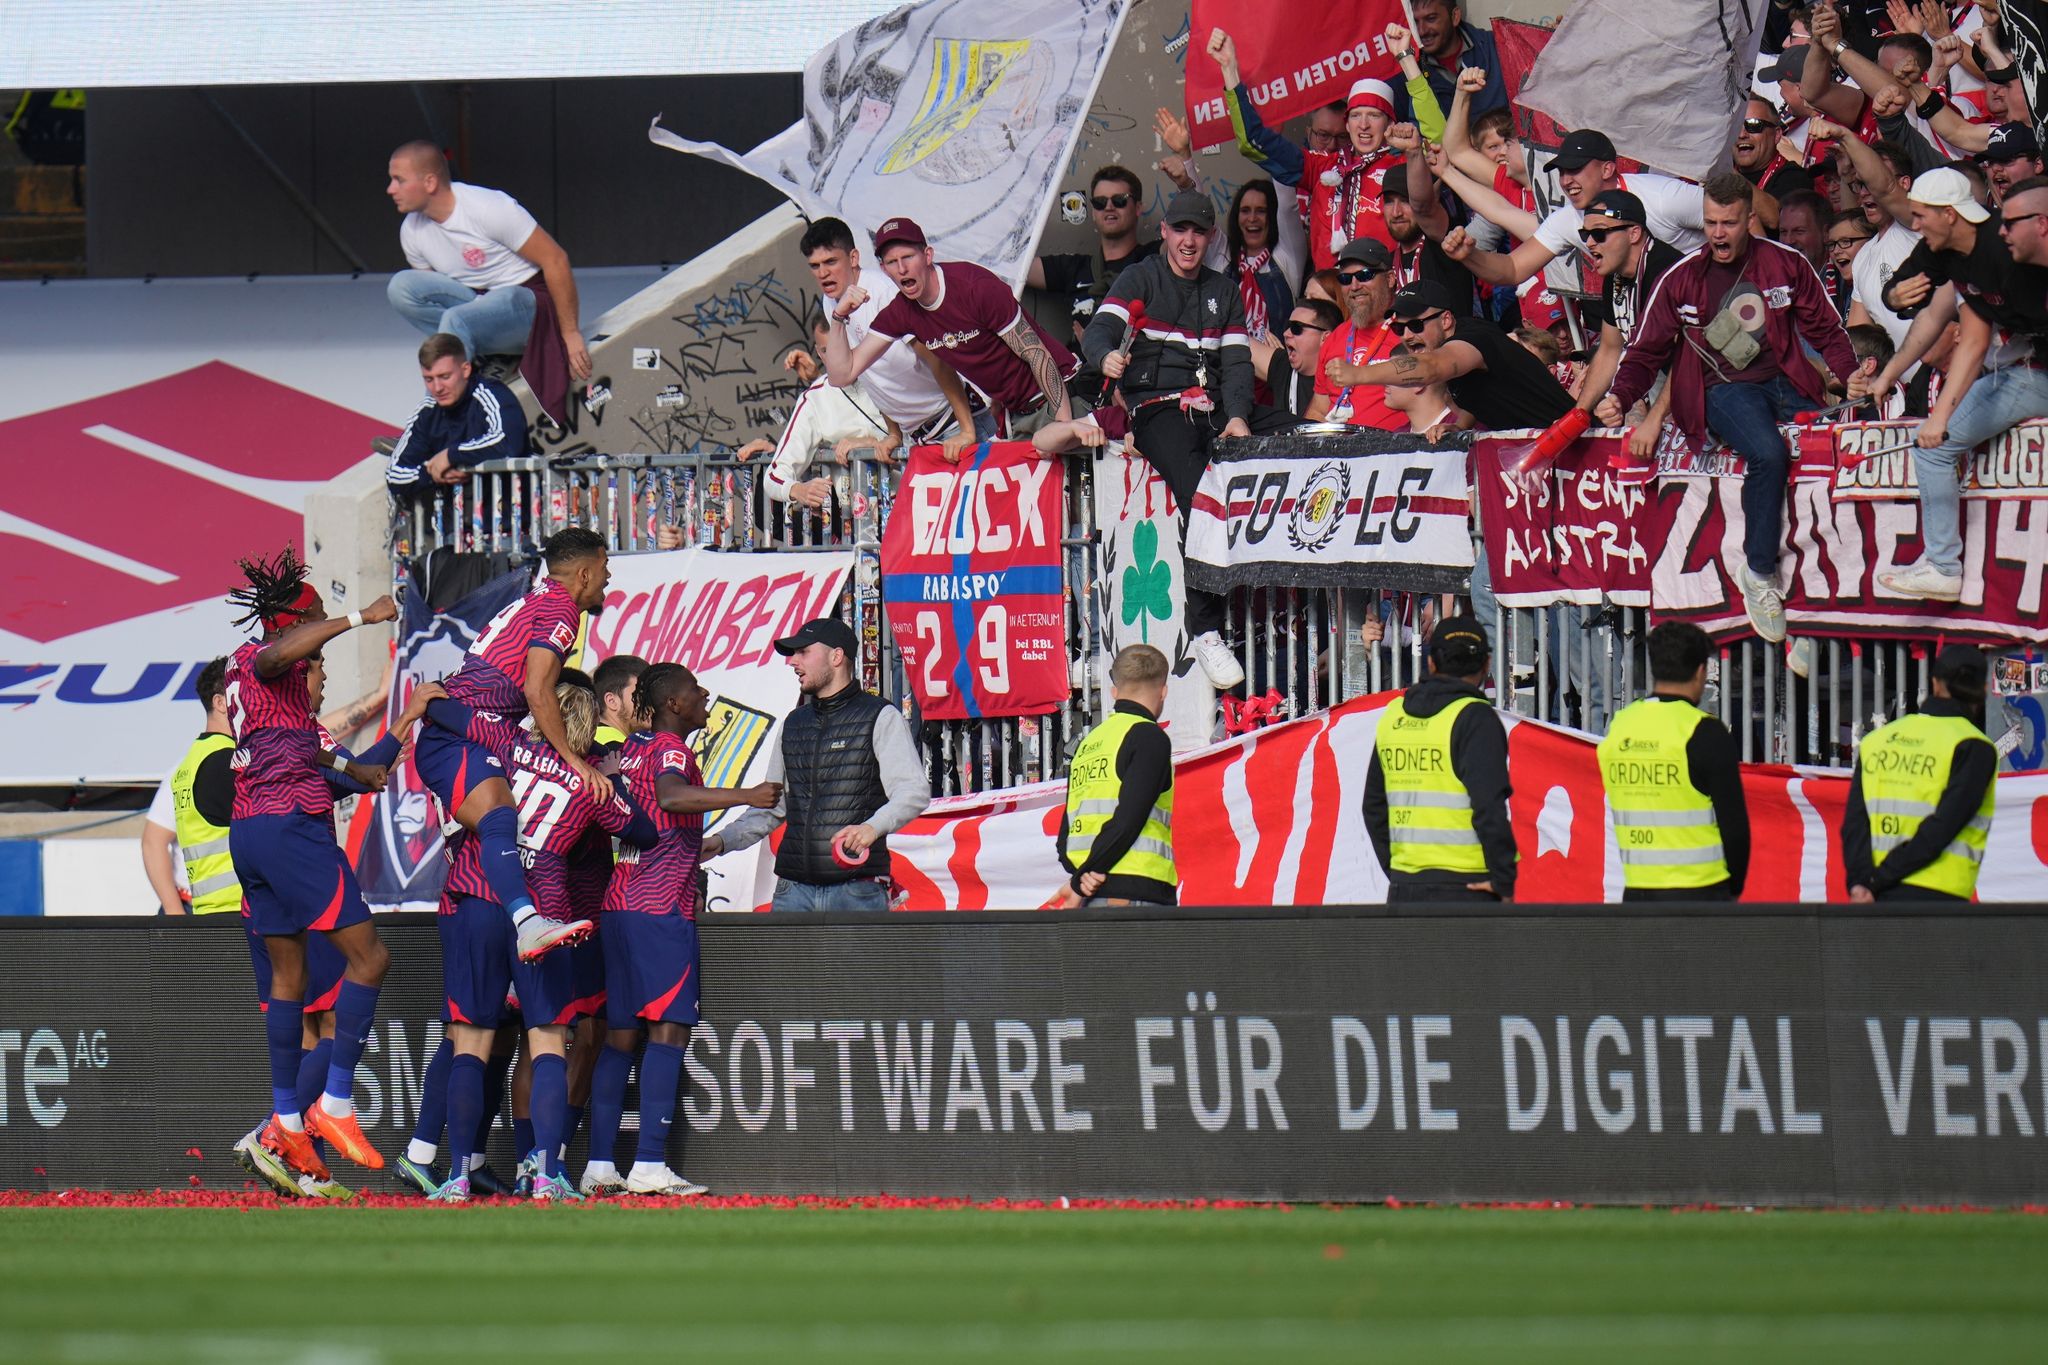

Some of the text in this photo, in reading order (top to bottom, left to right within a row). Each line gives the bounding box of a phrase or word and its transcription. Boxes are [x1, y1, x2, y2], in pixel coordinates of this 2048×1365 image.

[1689, 455, 1739, 476] NICHT
[1976, 425, 2048, 488] JUG
[588, 567, 843, 674] SCHWABEN
[978, 604, 1010, 693] 9
[1016, 639, 1054, 649] bei RBL
[1022, 651, 1047, 661] dabei
[513, 746, 533, 765] RB
[1609, 762, 1681, 786] ORDNER
[512, 769, 572, 851] 10
[1630, 829, 1654, 844] 500
[74, 1029, 109, 1068] AG
[683, 1018, 1093, 1133] SOFTWARE
[1135, 991, 1290, 1132] FÜR
[1332, 1014, 1459, 1131] DIE
[1501, 1014, 1823, 1134] DIGITAL
